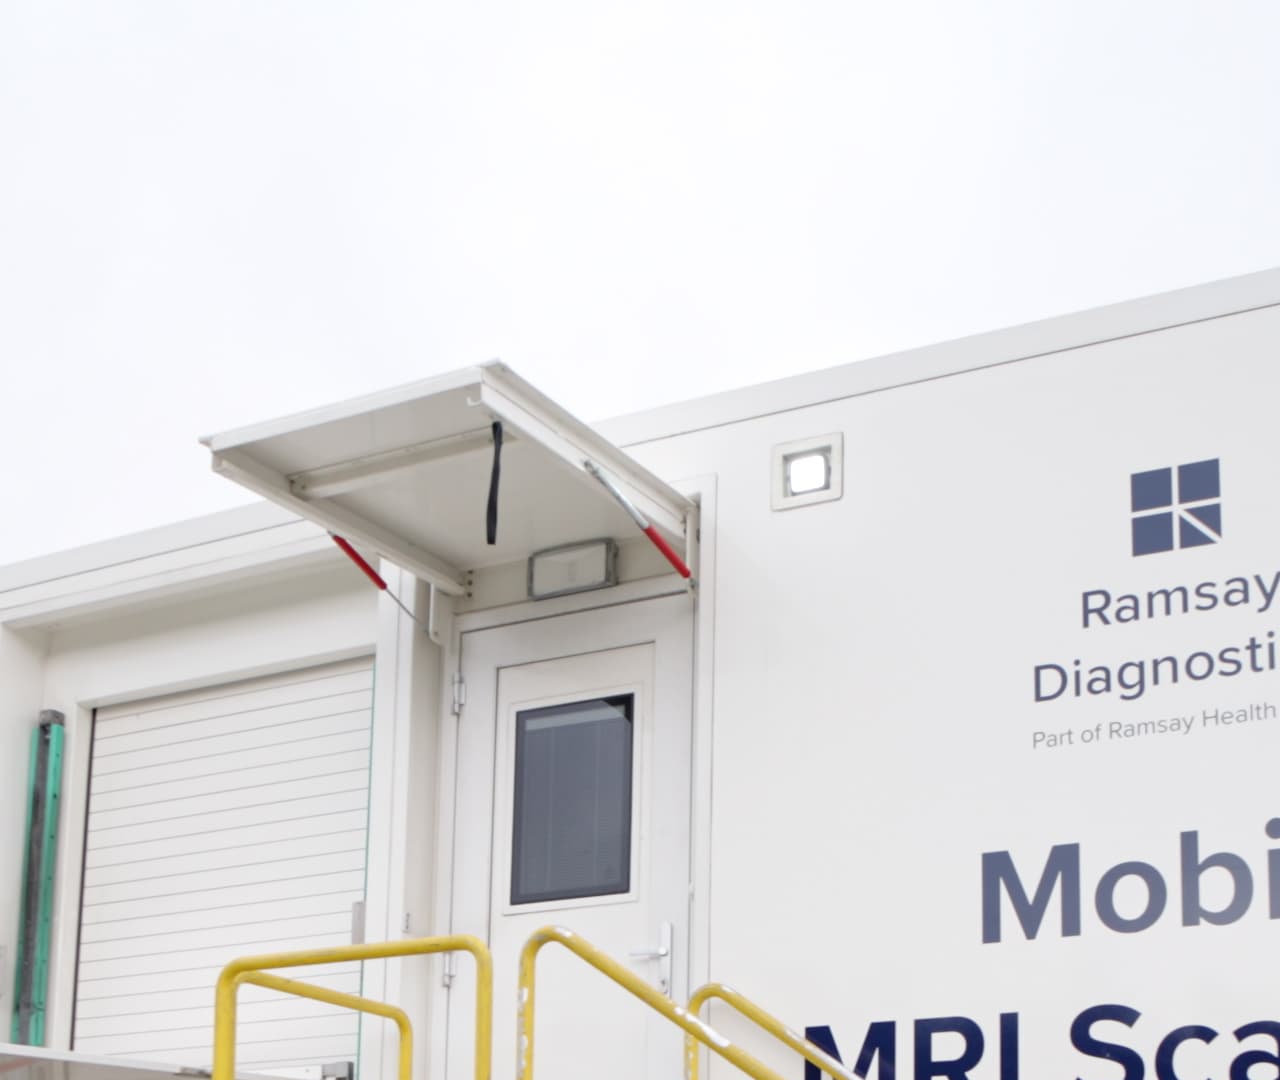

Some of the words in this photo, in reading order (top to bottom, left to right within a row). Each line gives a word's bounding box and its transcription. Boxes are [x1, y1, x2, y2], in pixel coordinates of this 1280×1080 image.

[1032, 727, 1075, 750] Part
[1080, 723, 1102, 744] of
[1108, 715, 1195, 741] Ramsay
[1202, 702, 1277, 727] Health
